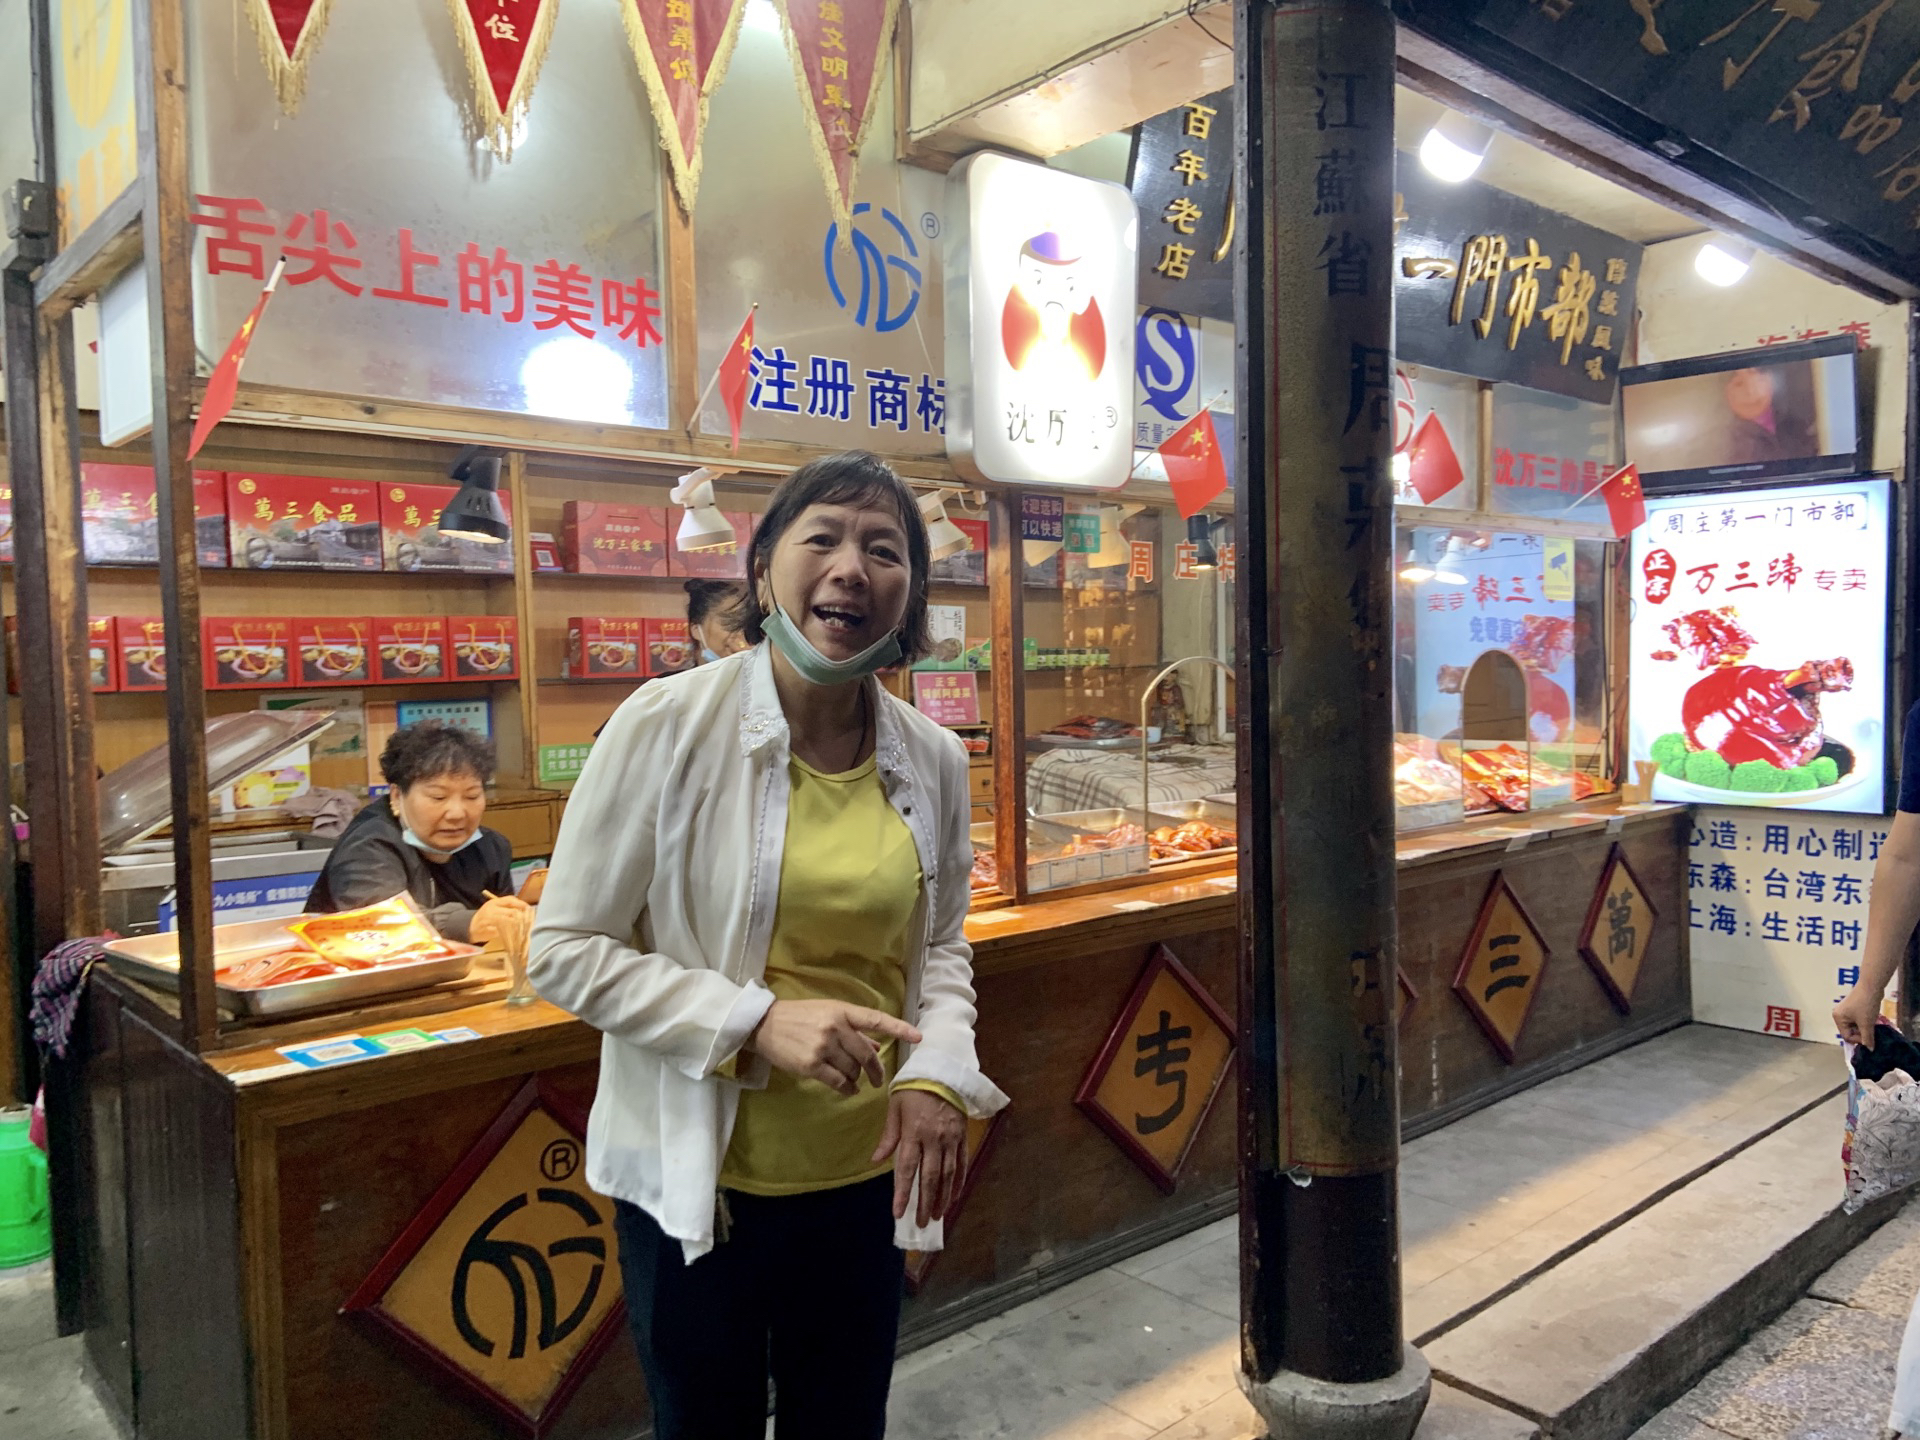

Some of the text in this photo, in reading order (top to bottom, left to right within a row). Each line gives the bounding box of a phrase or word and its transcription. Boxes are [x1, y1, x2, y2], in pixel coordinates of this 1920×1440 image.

[1157, 101, 1217, 280] 百年老店
[189, 193, 663, 349] 舌尖上的美味
[1394, 192, 1597, 366] 一門市部
[749, 346, 946, 435] 注册商标
[1494, 447, 1618, 496] 沈万三的最
[254, 497, 358, 524] 萬三食品
[1643, 550, 1675, 602] 正宗
[1686, 553, 1867, 594] 万三蹄 专卖
[1690, 860, 1876, 905] 东森:台湾东
[1607, 888, 1636, 964] 萬
[1485, 935, 1531, 1003] 三
[1763, 1005, 1800, 1038] 周
